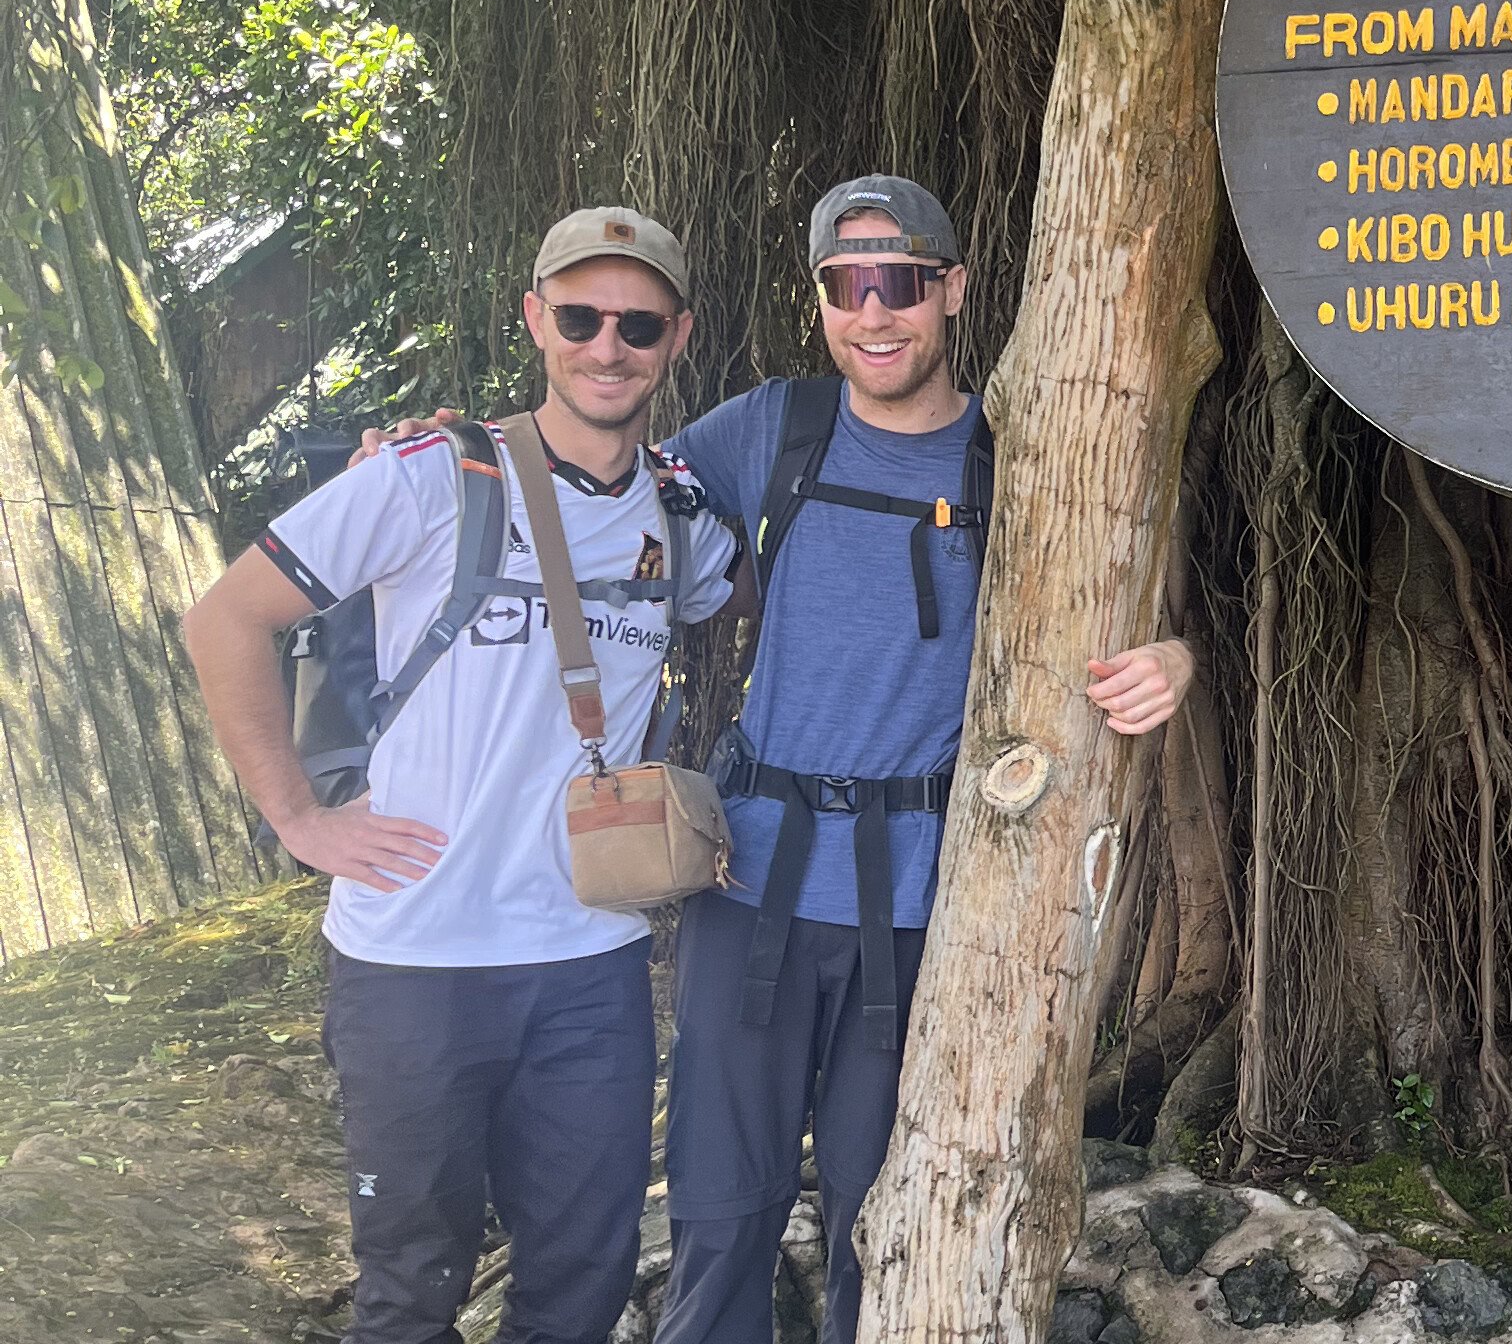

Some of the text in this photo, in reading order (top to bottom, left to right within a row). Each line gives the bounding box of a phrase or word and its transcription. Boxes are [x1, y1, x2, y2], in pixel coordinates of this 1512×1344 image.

[1285, 8, 1435, 60] FROM
[1347, 214, 1451, 264] KIBO
[1346, 281, 1501, 333] UHURU
